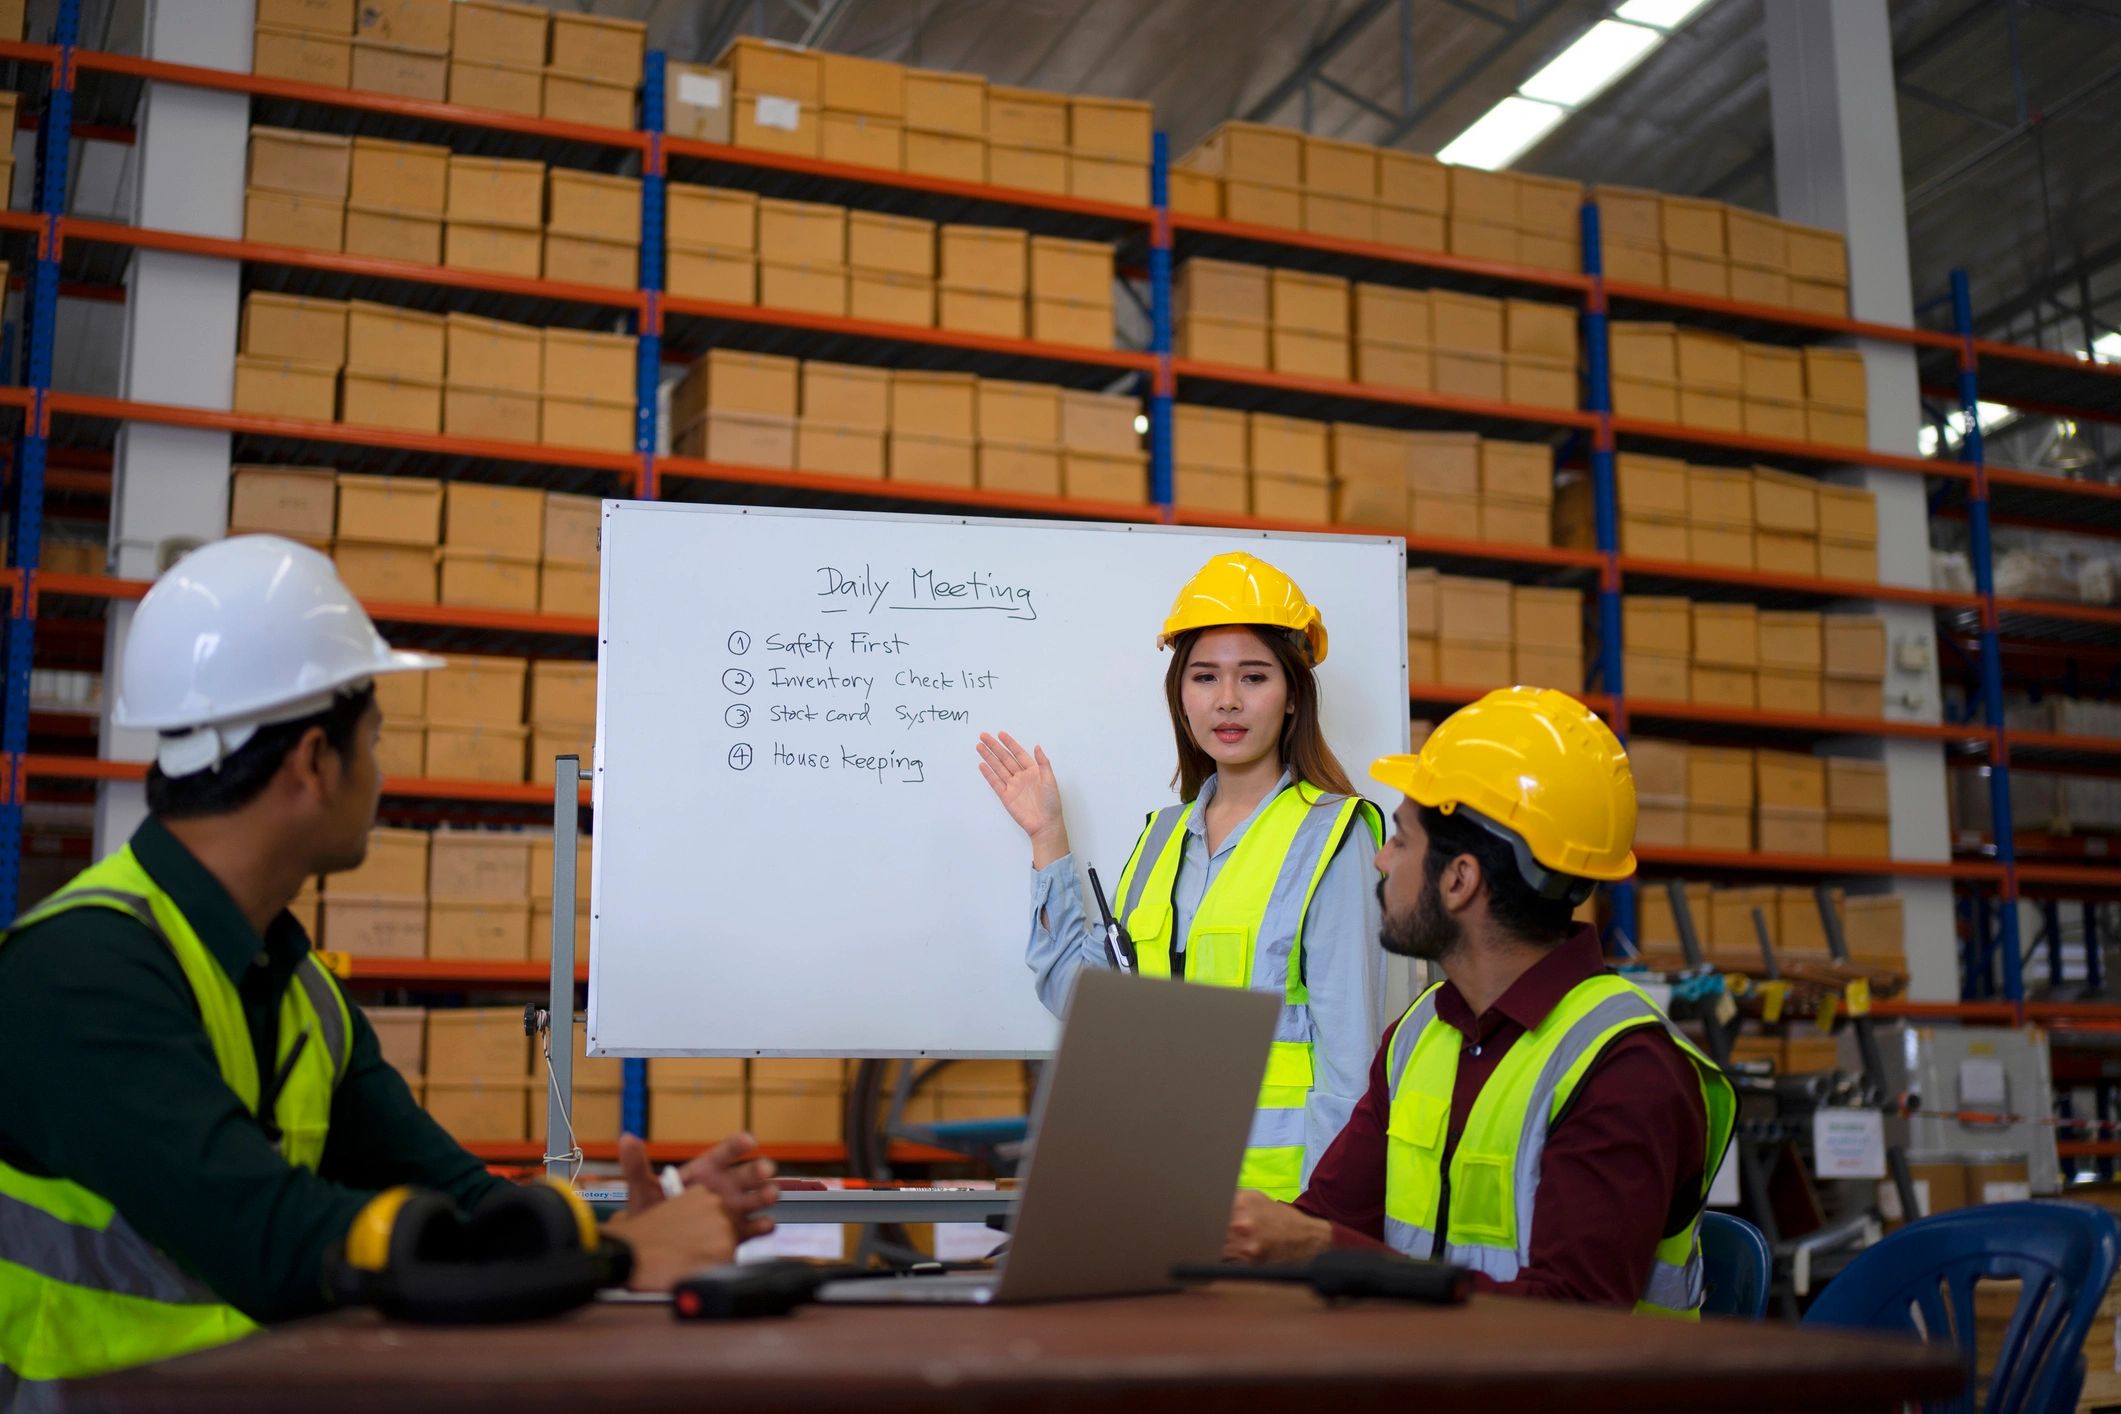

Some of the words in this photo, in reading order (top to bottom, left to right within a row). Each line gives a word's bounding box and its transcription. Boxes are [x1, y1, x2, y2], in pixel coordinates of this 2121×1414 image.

[817, 564, 889, 615] Daily
[911, 567, 1037, 620] Meeting
[766, 632, 835, 661] Safety
[850, 631, 911, 655] First
[768, 665, 874, 700] Inventory
[895, 703, 969, 731] System
